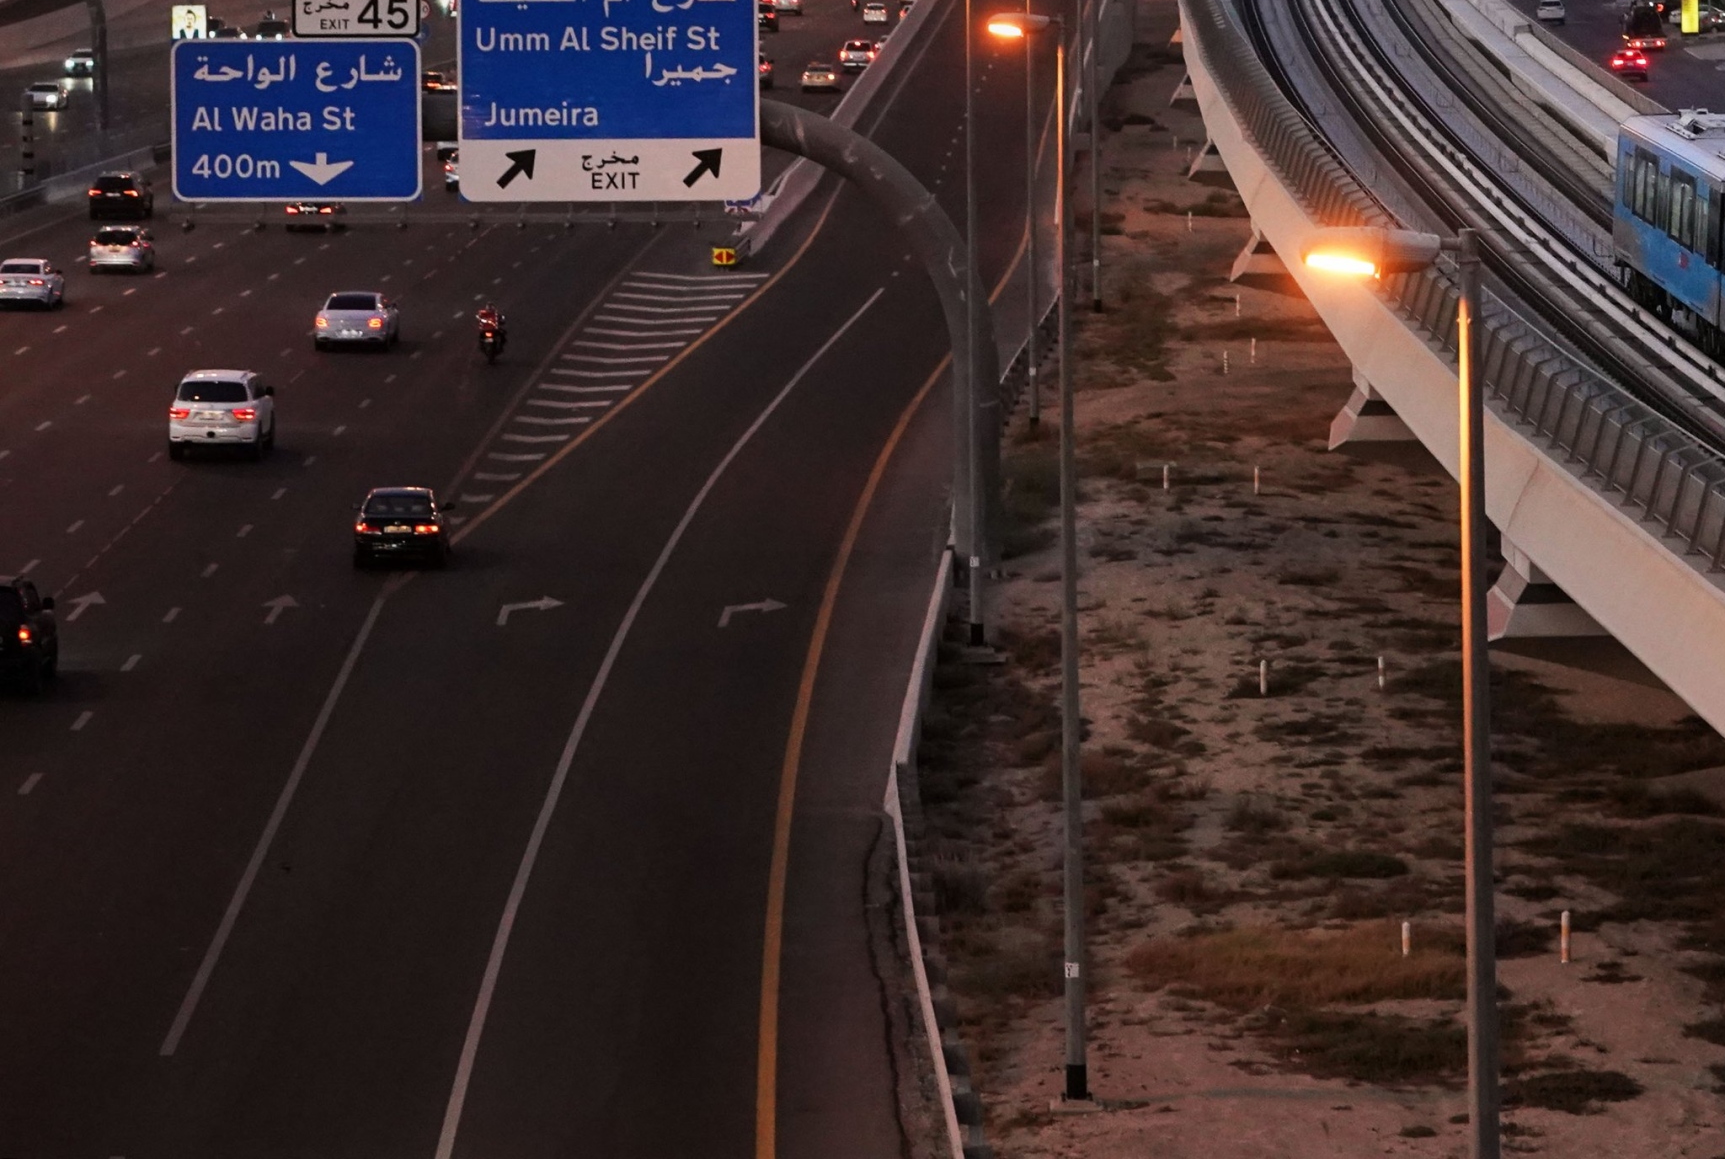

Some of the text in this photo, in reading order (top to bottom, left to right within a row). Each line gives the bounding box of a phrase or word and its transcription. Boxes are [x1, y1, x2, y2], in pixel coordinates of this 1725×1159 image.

[320, 18, 350, 30] EXIT
[475, 26, 720, 52] Umm Al Sheif St
[193, 53, 402, 92] شارع الواحة
[645, 51, 738, 87] جميرا
[191, 106, 356, 132] Al Waha St
[484, 101, 599, 127] Jumeira
[191, 154, 281, 179] 400m
[581, 150, 640, 171] مخرج
[591, 172, 640, 190] EXIT
